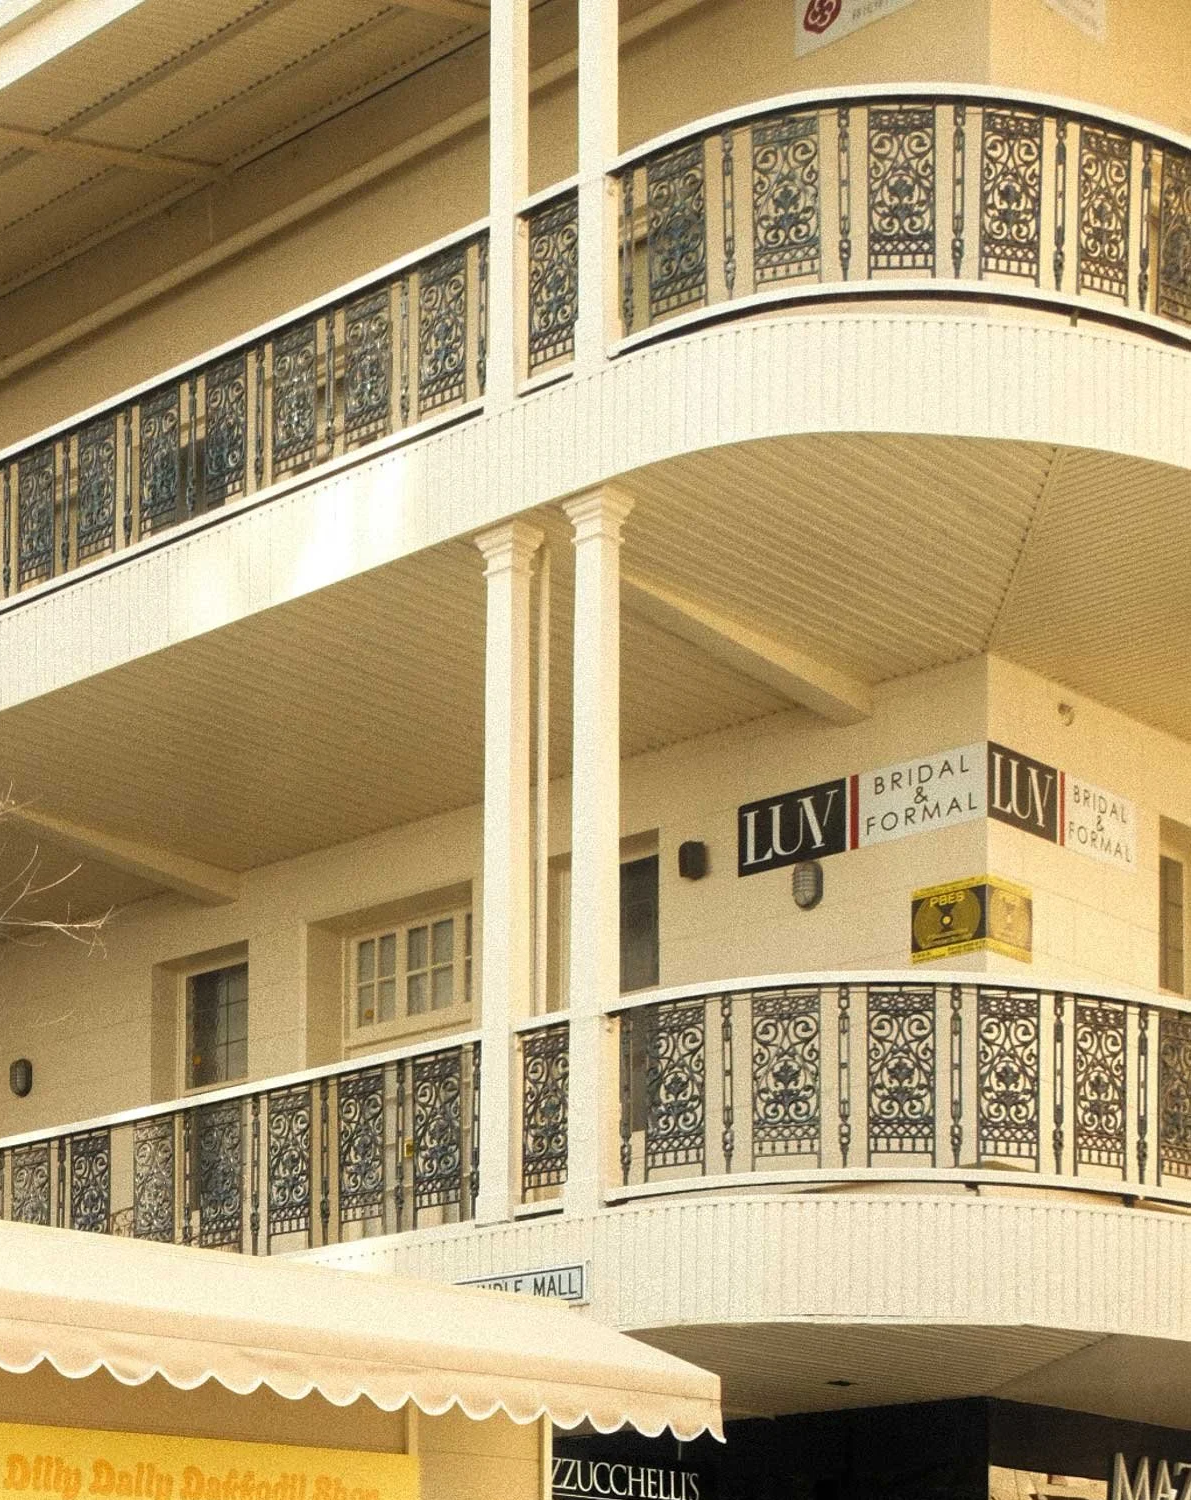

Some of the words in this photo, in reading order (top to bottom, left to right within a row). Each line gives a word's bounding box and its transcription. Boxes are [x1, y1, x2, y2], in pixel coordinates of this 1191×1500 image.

[874, 755, 969, 795] BRIDAL
[914, 786, 928, 804] &
[992, 752, 1054, 828] LUV
[866, 792, 977, 836] FORMAL
[1073, 785, 1127, 824] BRIDAL
[742, 789, 839, 866] LUV
[1068, 821, 1132, 863] FORMAL
[533, 1272, 577, 1297] MALL
[2, 1453, 82, 1500] Dilly
